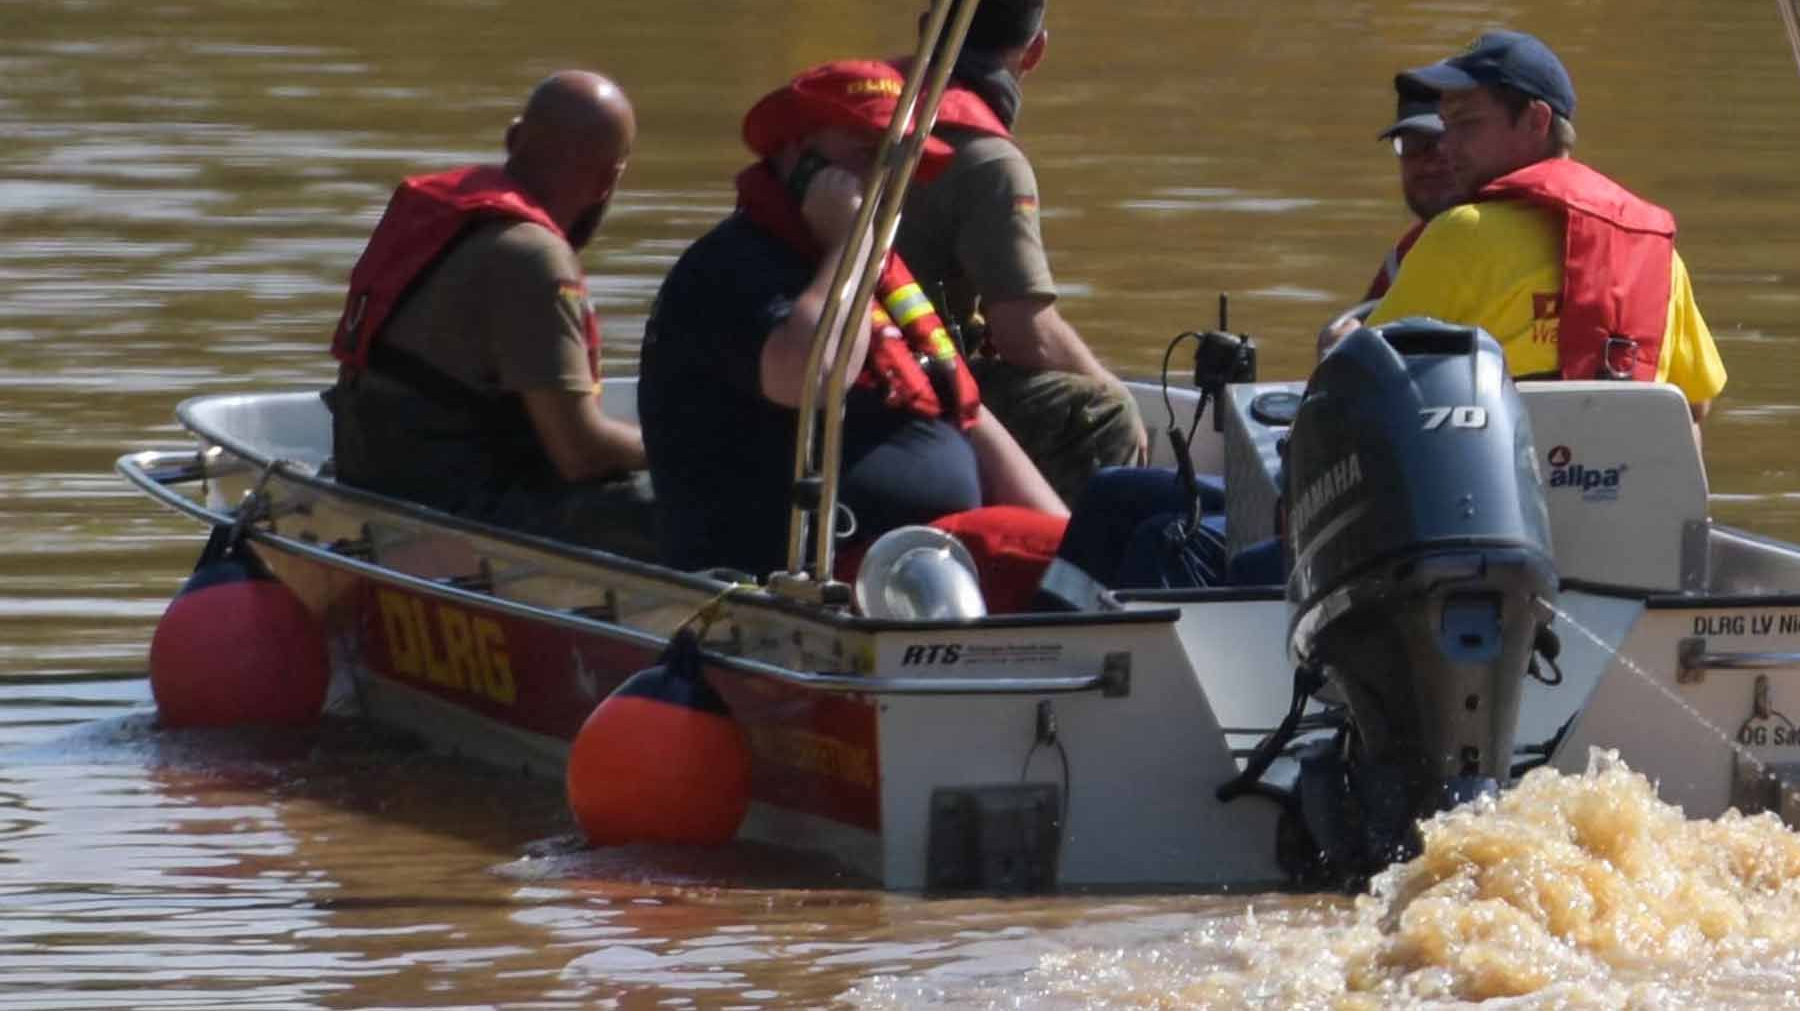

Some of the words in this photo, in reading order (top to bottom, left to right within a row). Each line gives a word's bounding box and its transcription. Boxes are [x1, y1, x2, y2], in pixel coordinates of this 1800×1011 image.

[1418, 405, 1488, 430] 70
[1550, 464, 1619, 490] allpa
[1694, 615, 1745, 635] DLRG
[1752, 615, 1773, 635] LV
[378, 589, 517, 704] DLRG
[902, 644, 963, 666] RTS
[1741, 726, 1768, 746] OG
